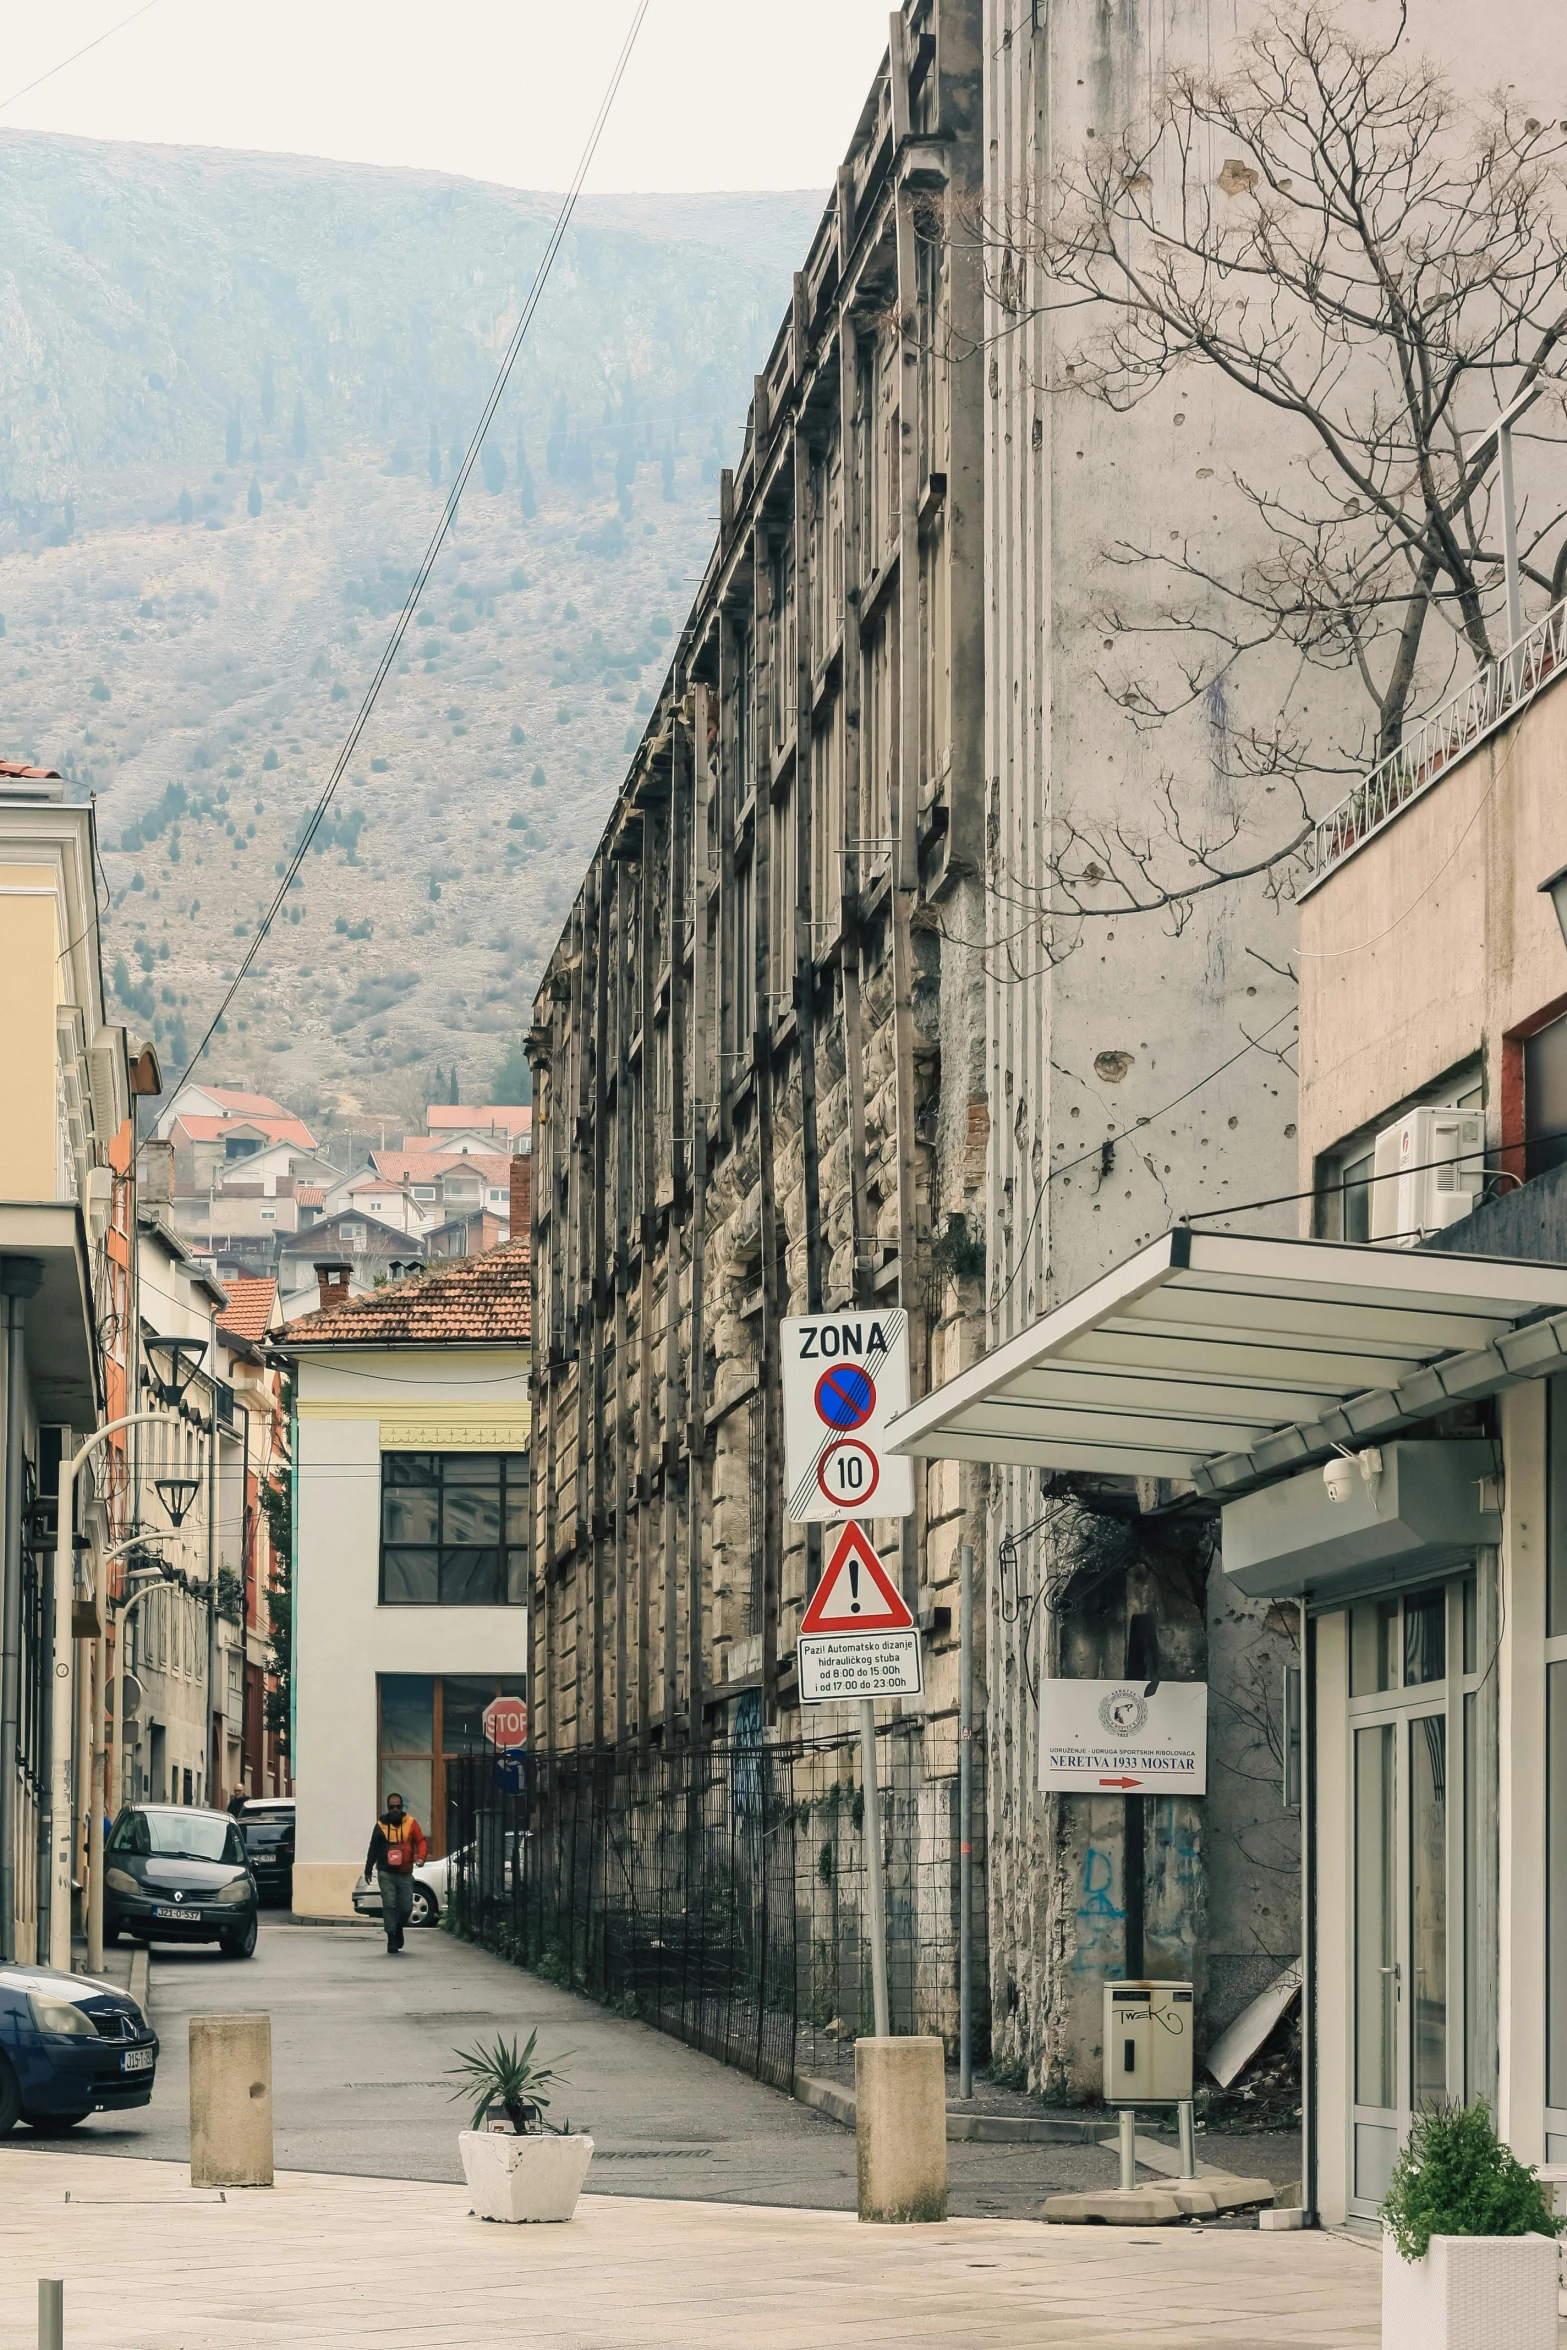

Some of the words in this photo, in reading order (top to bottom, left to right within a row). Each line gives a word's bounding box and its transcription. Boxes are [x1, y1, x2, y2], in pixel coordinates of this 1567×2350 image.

[799, 1322, 888, 1359] ZONA
[837, 1456, 863, 1489] 10
[804, 1645, 825, 1655] Pazi!
[828, 1641, 880, 1654] Automatsko
[882, 1639, 913, 1650] dizanje
[819, 1656, 872, 1667] hidrauličkog
[875, 1653, 900, 1662] stuba
[820, 1669, 831, 1679] od
[833, 1667, 855, 1678] 8:00
[857, 1668, 868, 1676] do
[870, 1665, 900, 1676] 15:00h
[820, 1682, 831, 1691] od
[833, 1680, 857, 1691] 17:00
[860, 1680, 871, 1689] do
[873, 1677, 906, 1689] 23:00h
[1050, 1755, 1109, 1768] NERETVA
[1113, 1757, 1137, 1768] 1933
[1141, 1758, 1195, 1770] MOSTAR
